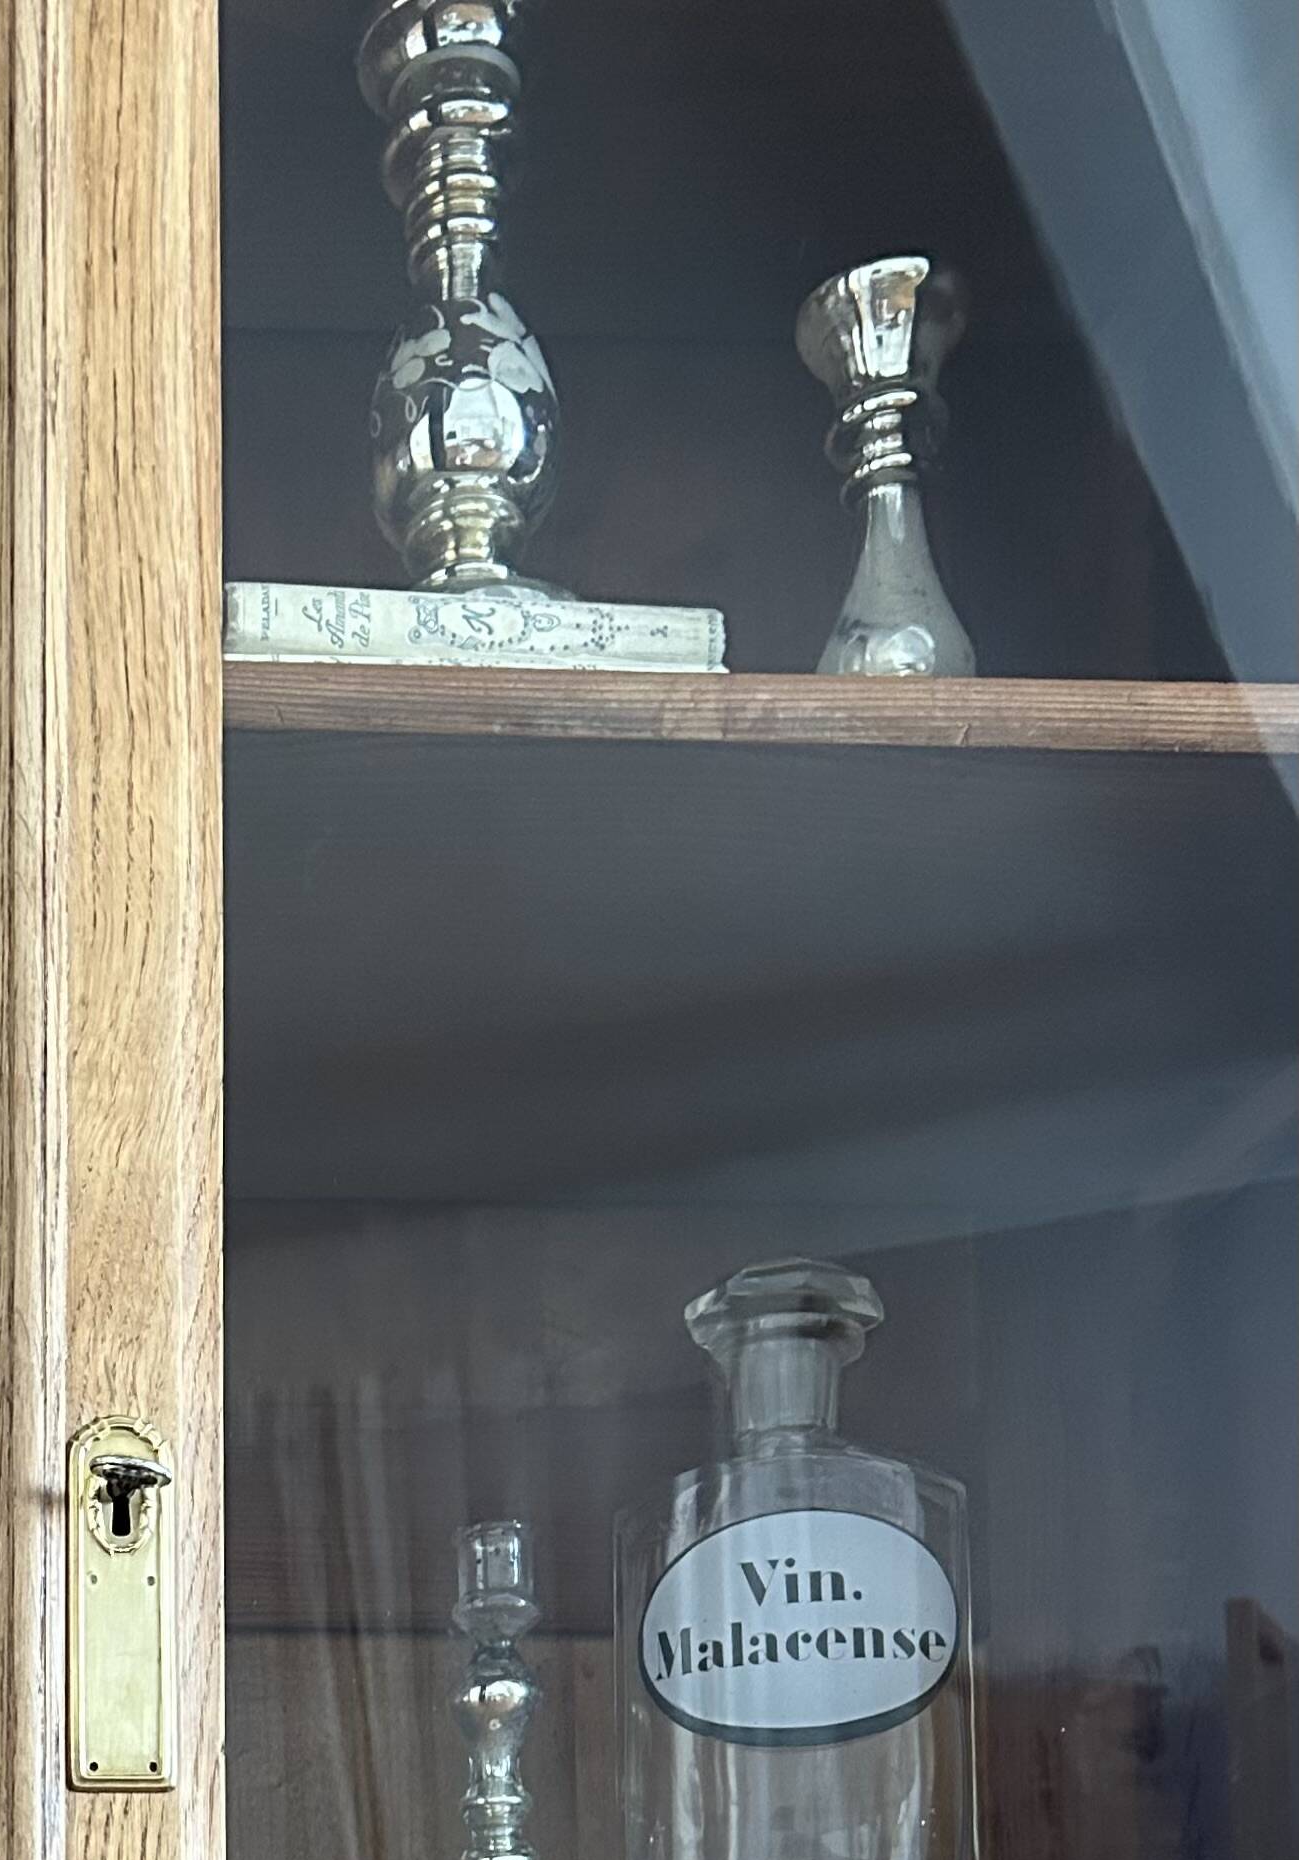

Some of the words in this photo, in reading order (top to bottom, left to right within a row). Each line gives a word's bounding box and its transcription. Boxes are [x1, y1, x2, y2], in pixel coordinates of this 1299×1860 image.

[302, 598, 323, 632] Les
[352, 624, 371, 648] de
[740, 1557, 862, 1607] Vin.
[656, 1622, 947, 1681] Malacense
